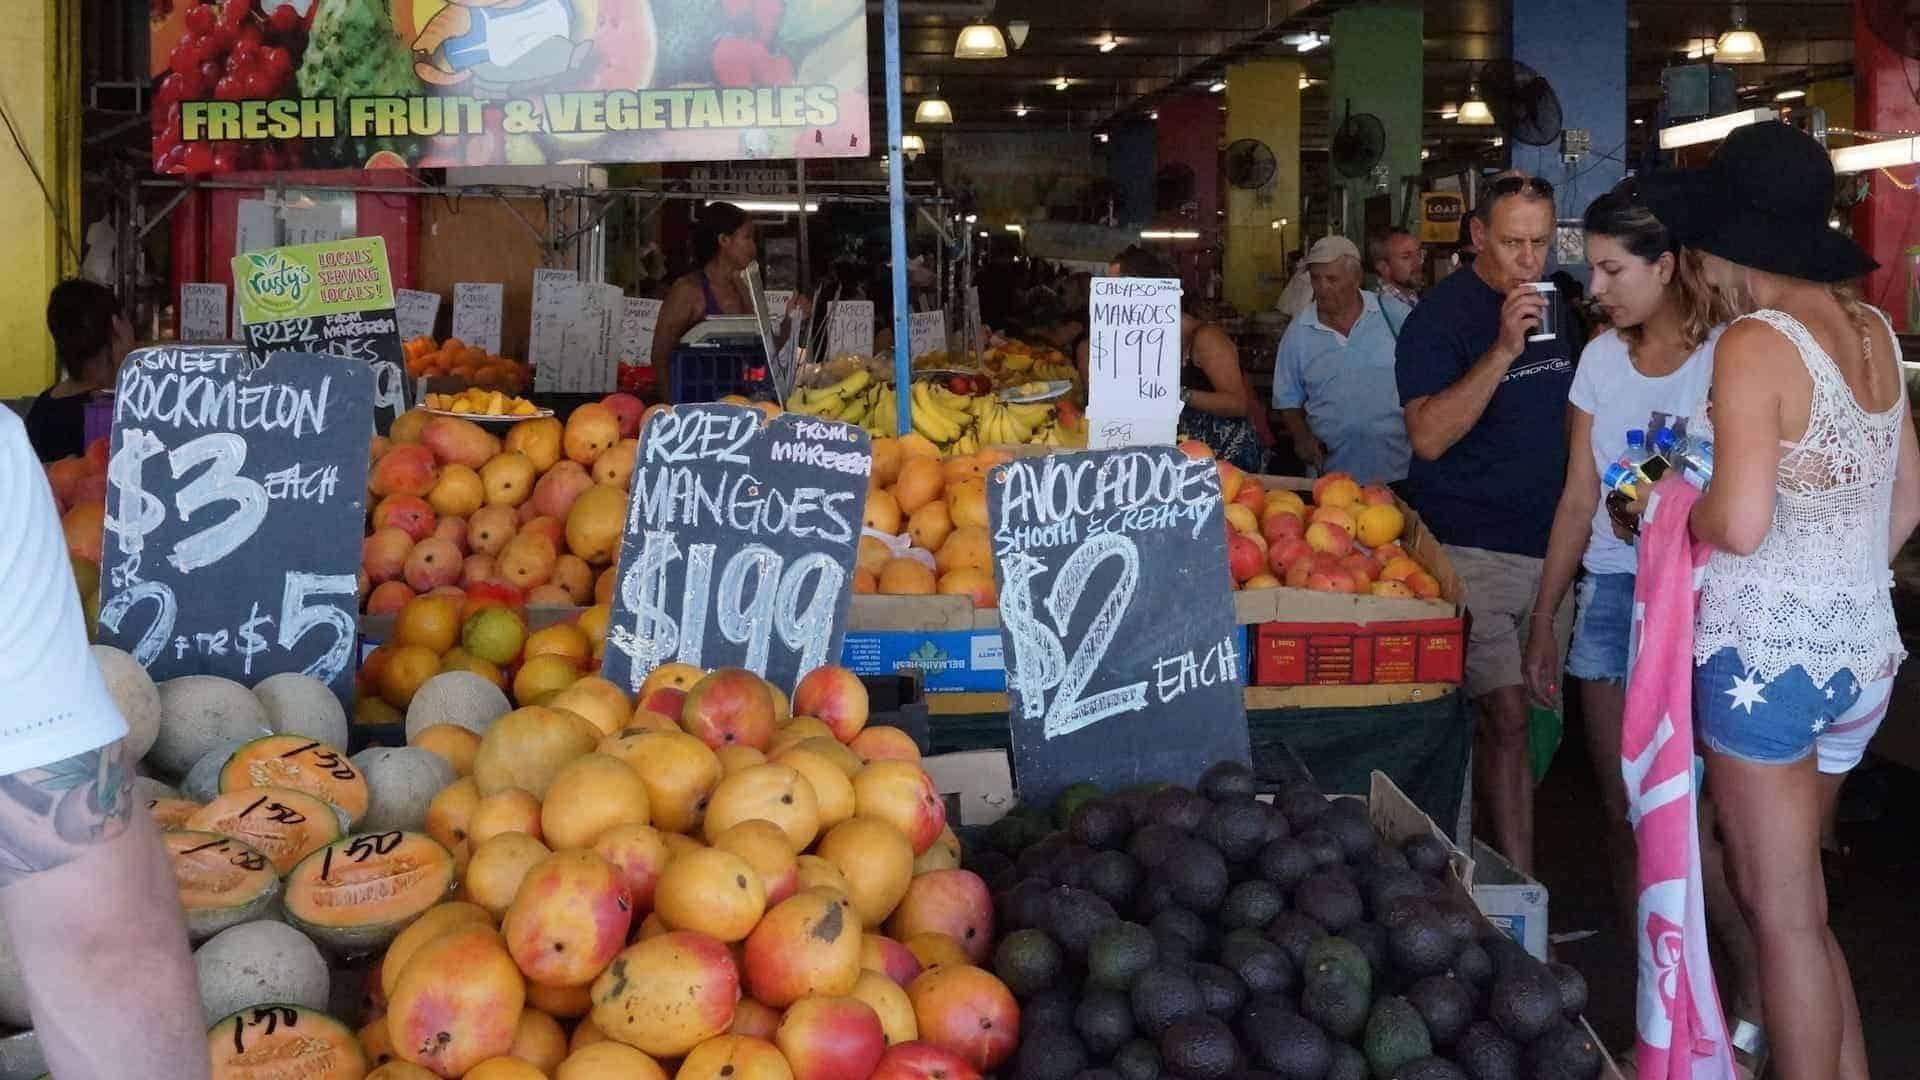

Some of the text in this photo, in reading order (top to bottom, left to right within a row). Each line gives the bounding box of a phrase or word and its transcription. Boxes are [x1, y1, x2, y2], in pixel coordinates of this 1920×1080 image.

[181, 84, 839, 141] FRESH FRUIT & VEGETABLES
[250, 258, 312, 300] rusty's
[317, 266, 380, 286] SERVING
[318, 249, 373, 268] LOCALS
[319, 285, 383, 304] LOCALS!
[1095, 281, 1157, 298] CALYPSO
[250, 319, 320, 348] R2E2
[326, 312, 362, 326] FROM
[1094, 303, 1177, 328] MANGOES
[143, 351, 231, 374] SWEET
[115, 370, 332, 439] ROCKMELON
[646, 409, 759, 464] R2E2
[795, 421, 848, 441] FROM
[104, 427, 269, 575] $3
[264, 462, 339, 504] EACH
[1001, 452, 1220, 528] AVOCADOES
[628, 465, 856, 545] MANGOES
[994, 518, 1078, 556] SMOOTH
[234, 570, 359, 686] $5
[608, 530, 847, 693] $199
[999, 532, 1150, 740] $2
[1151, 636, 1240, 703] EACH
